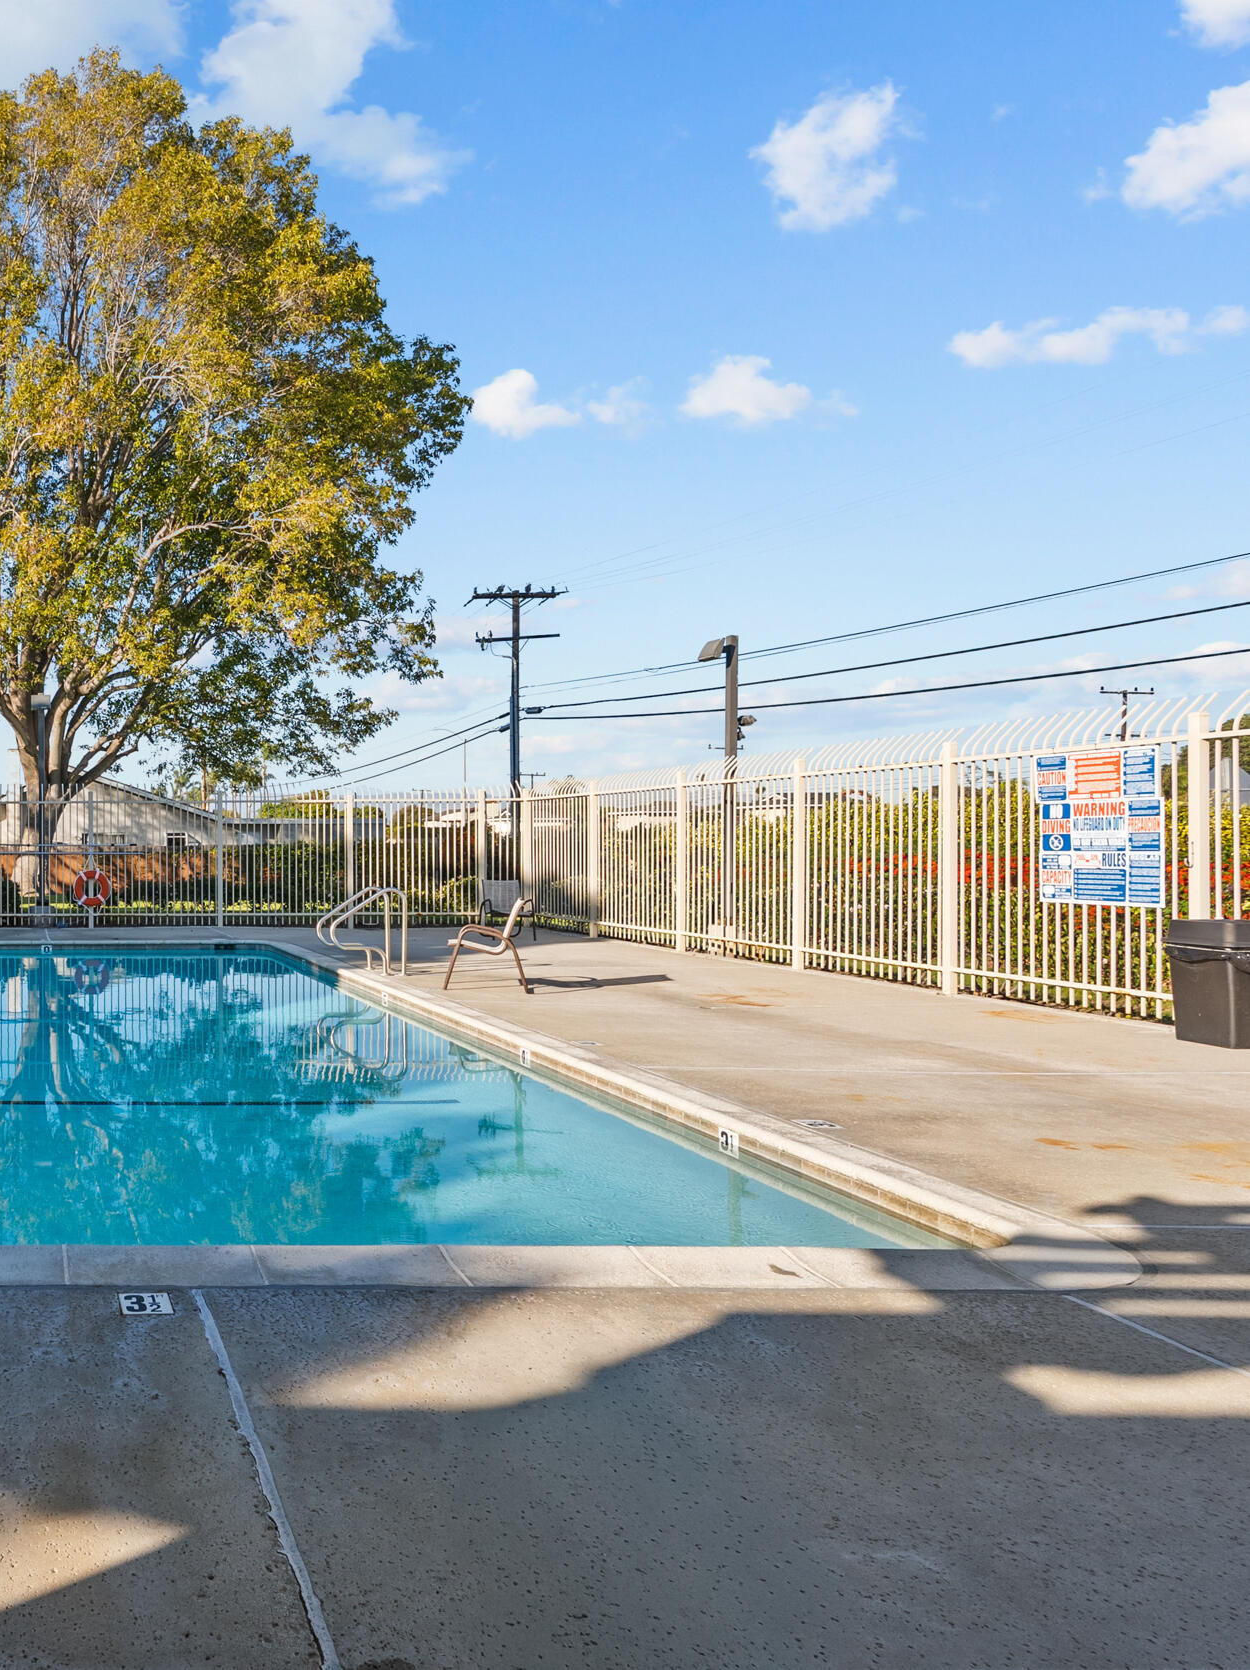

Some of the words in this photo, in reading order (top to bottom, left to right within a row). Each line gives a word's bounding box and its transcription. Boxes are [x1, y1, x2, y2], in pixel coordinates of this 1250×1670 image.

[1037, 771, 1066, 785] CAUTION
[1049, 804, 1063, 819] NO
[1073, 801, 1126, 817] WARNING
[1042, 819, 1071, 833] DIVING
[1102, 853, 1126, 867] RULES
[1042, 870, 1072, 884] CAPACITY
